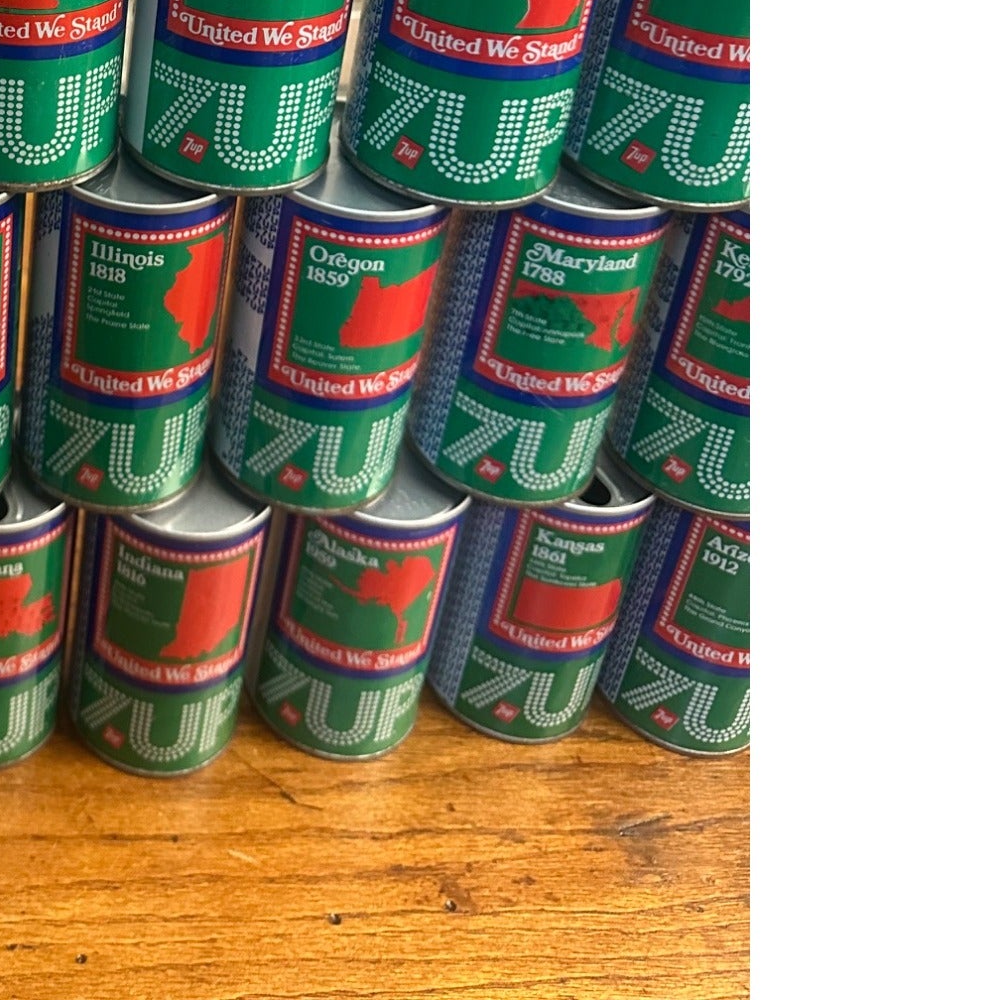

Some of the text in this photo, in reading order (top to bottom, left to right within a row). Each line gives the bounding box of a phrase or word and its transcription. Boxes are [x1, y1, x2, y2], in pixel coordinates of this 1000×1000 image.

[403, 17, 577, 64] United We Stand
[363, 60, 574, 185] 7UP
[91, 240, 165, 270] Illinois
[309, 245, 384, 274] Oregon
[526, 243, 638, 273] Maryland
[89, 261, 126, 284] 1818
[306, 265, 349, 288] 1859
[522, 261, 565, 286] 1788
[487, 359, 593, 391] United We
[308, 529, 380, 568] Alaska
[532, 545, 566, 565] 1861
[535, 528, 604, 554] Kansas
[118, 545, 185, 581] Indiana
[702, 550, 739, 576] 1912
[667, 625, 734, 664] United
[260, 640, 424, 746] 7UP
